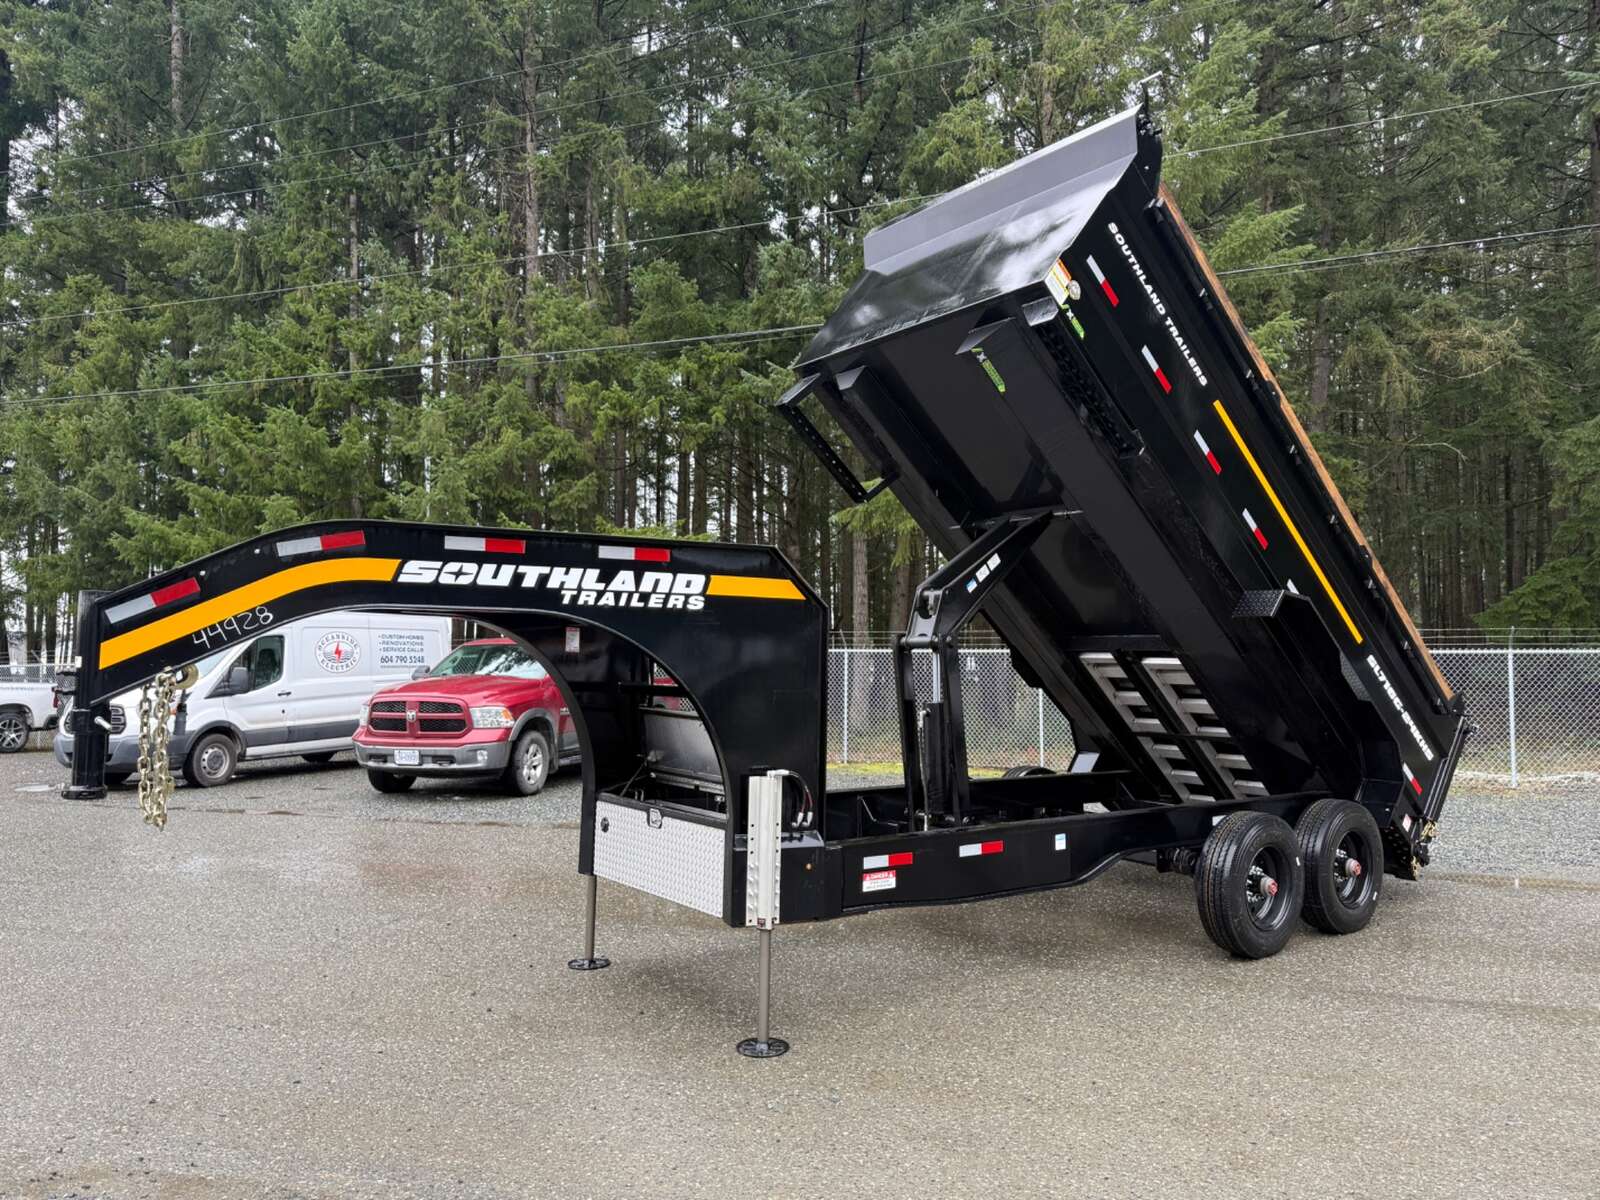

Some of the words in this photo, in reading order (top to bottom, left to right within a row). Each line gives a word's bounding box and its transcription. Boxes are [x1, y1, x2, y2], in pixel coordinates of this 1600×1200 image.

[1108, 221, 1167, 315] SOUTHLAND
[1164, 316, 1209, 388] TRAILERS
[397, 560, 706, 595] SOUTHLAND
[560, 589, 706, 610] TRAILERS
[192, 606, 273, 649] 44928
[320, 656, 357, 671] ELECTRIC
[380, 655, 393, 664] 604
